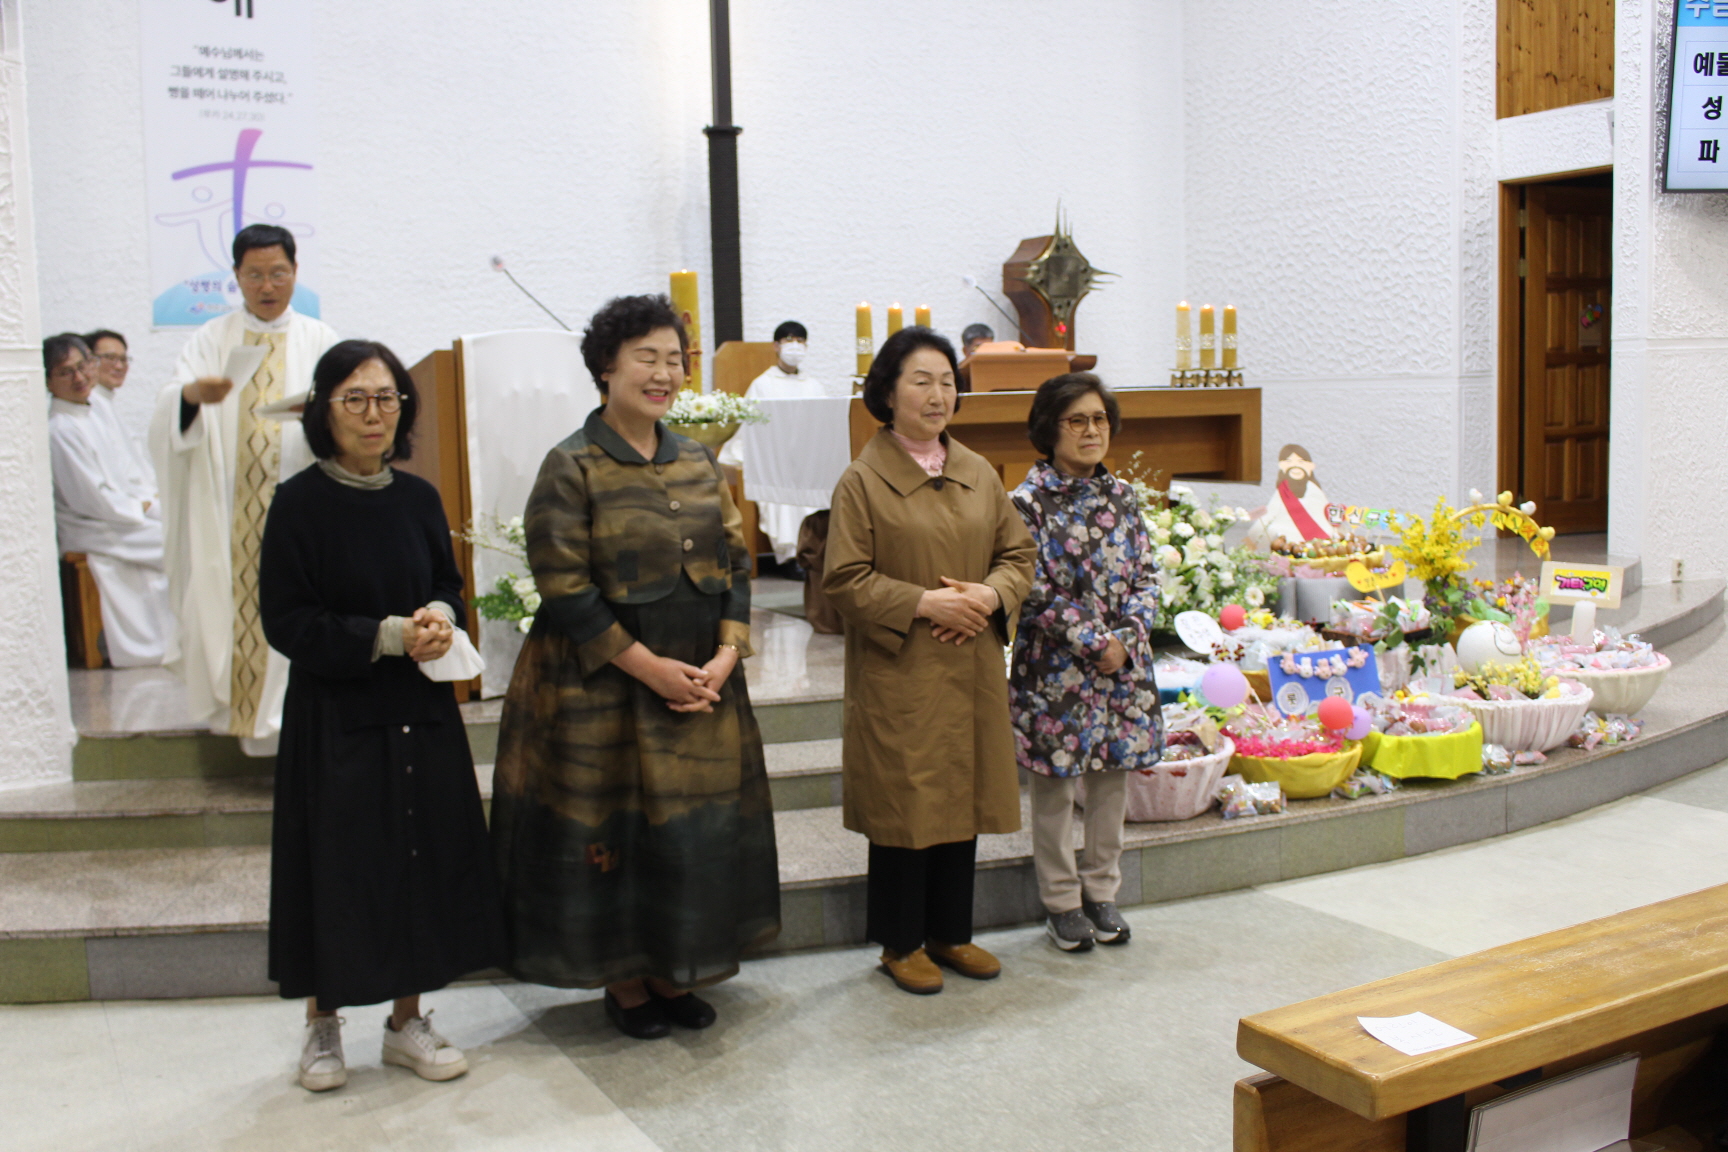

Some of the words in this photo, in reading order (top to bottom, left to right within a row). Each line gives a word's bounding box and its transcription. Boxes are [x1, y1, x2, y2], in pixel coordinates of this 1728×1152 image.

[170, 65, 215, 79] 그들에게
[217, 68, 250, 81] 설명해
[252, 69, 288, 84] 주시고,
[167, 86, 190, 99] 빵을
[217, 88, 250, 101] 나누어
[1702, 96, 1723, 120] 성
[1698, 139, 1720, 163] 파
[1555, 575, 1608, 592] 기타구역
[1375, 1019, 1417, 1032] 어린이
